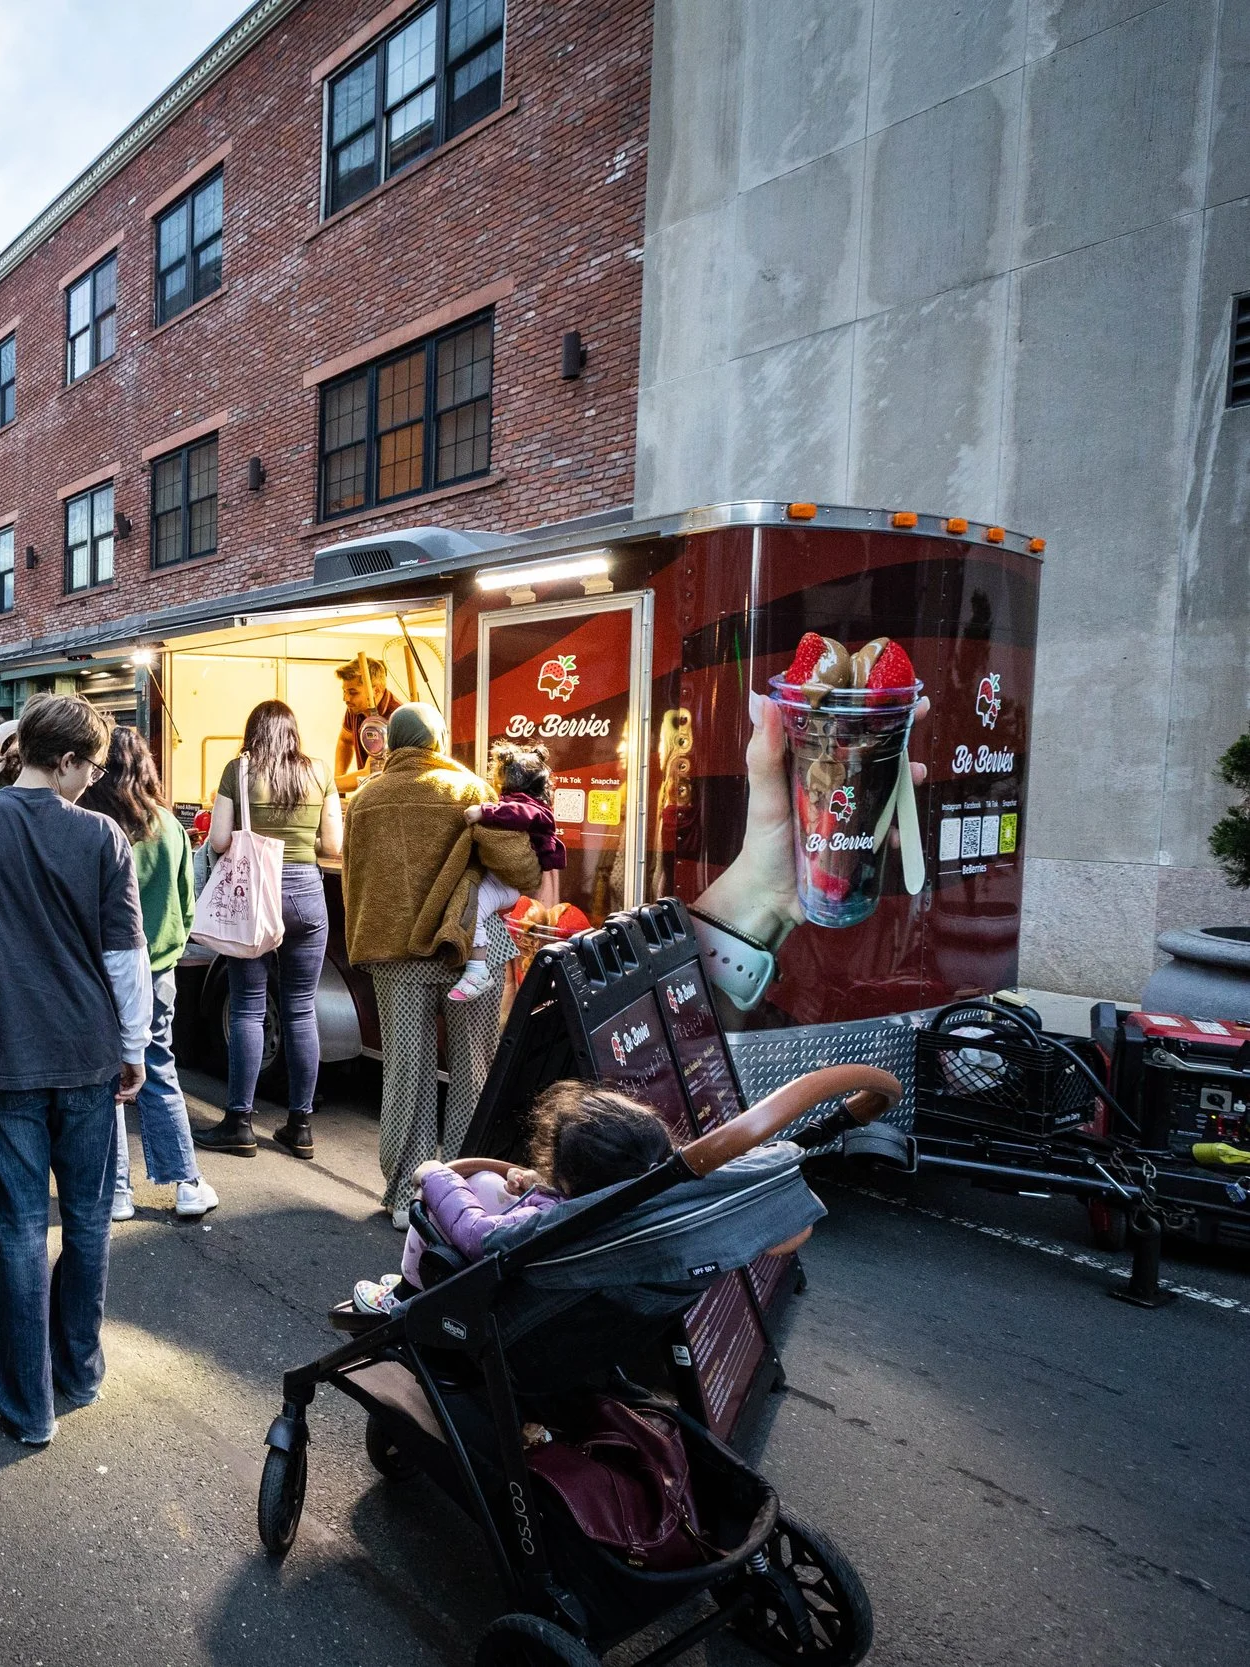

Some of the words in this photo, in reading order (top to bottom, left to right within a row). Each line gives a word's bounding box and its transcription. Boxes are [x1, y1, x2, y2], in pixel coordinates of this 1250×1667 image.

[505, 714, 536, 738] Be
[538, 713, 611, 738] Berries
[952, 744, 973, 774] Be
[974, 744, 1015, 773] Berries
[559, 776, 569, 784] Tik
[570, 776, 582, 784] Tok
[590, 777, 620, 785] Snapchat
[963, 801, 982, 809] Facebook
[805, 833, 828, 852] Be
[829, 831, 875, 852] Berries
[962, 863, 987, 875] BeBerries
[692, 1267, 704, 1276] UPF
